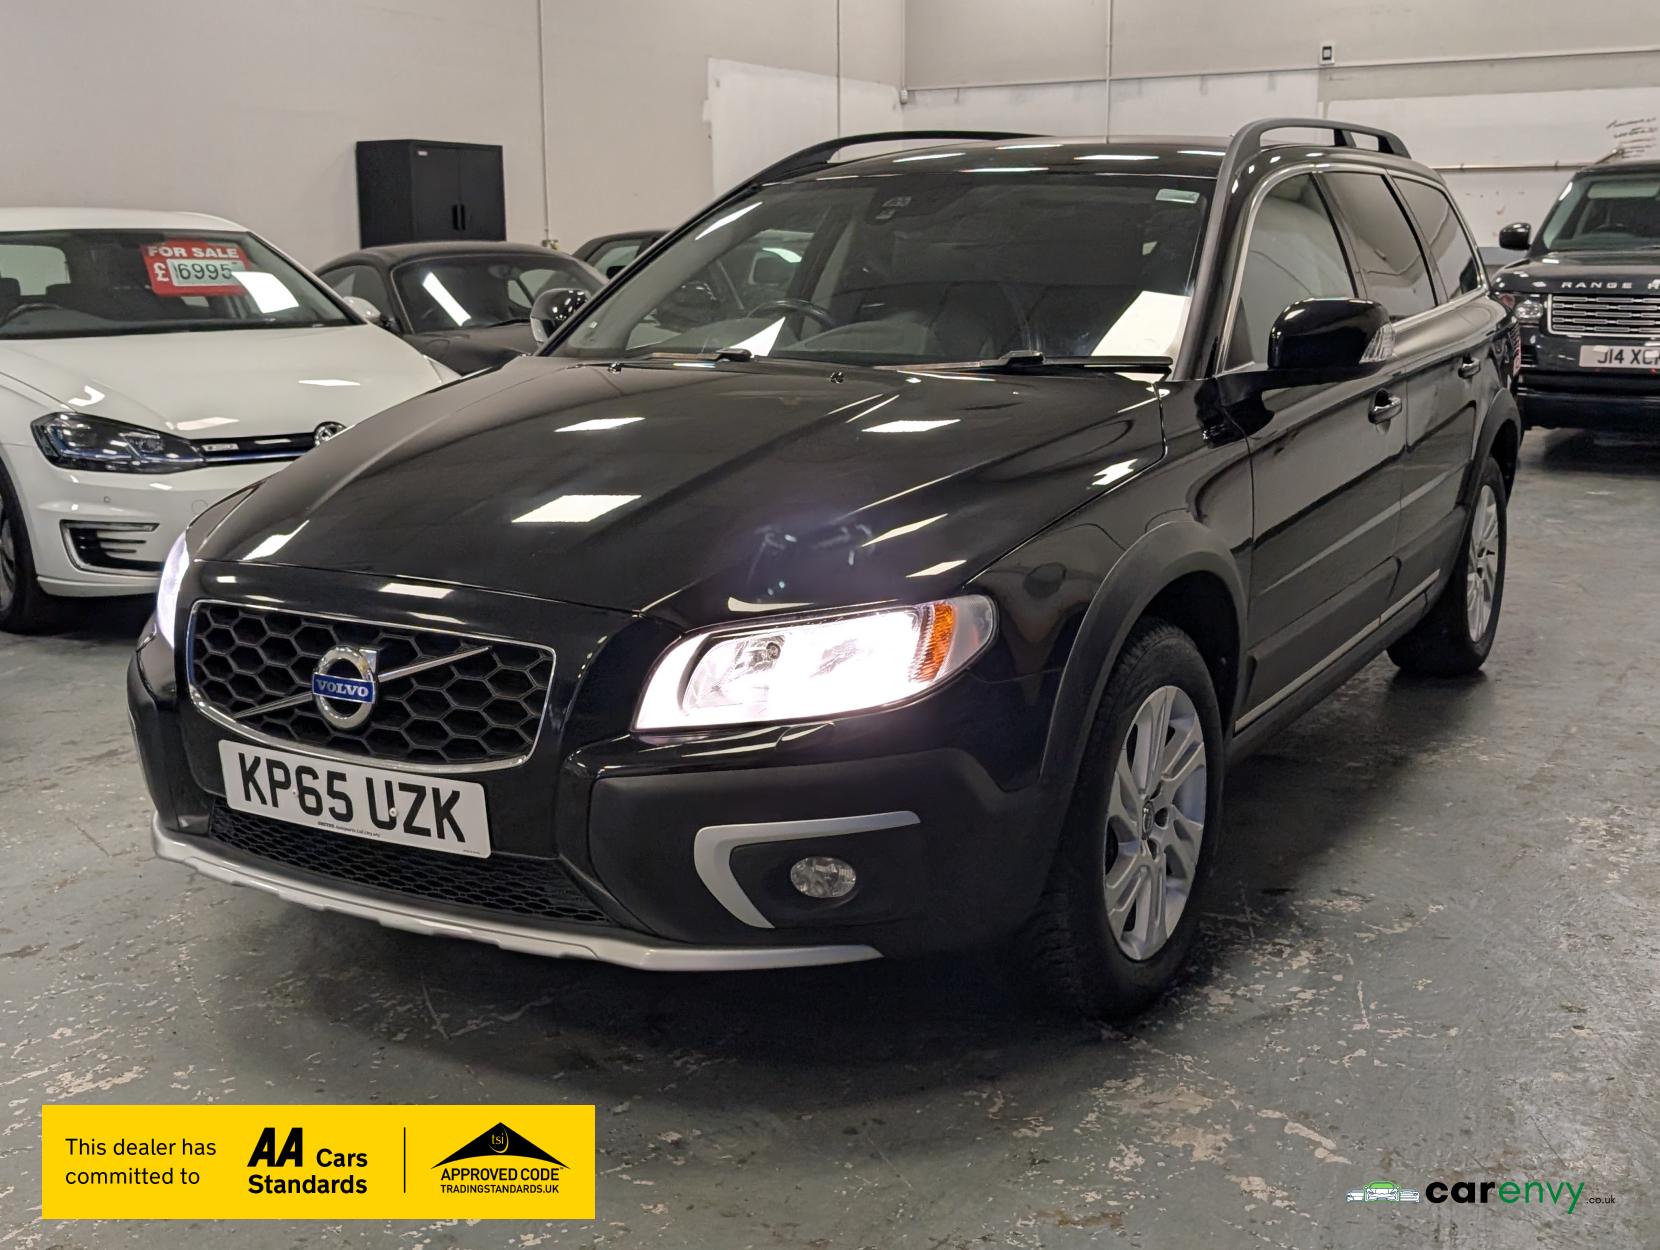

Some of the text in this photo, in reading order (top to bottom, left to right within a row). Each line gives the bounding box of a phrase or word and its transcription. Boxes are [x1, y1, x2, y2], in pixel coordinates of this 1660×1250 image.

[147, 246, 240, 258] FOR SALE
[153, 262, 170, 281] £
[1560, 281, 1633, 289] RANGE
[315, 679, 369, 697] VOLVO
[237, 752, 466, 843] KP65 UZK
